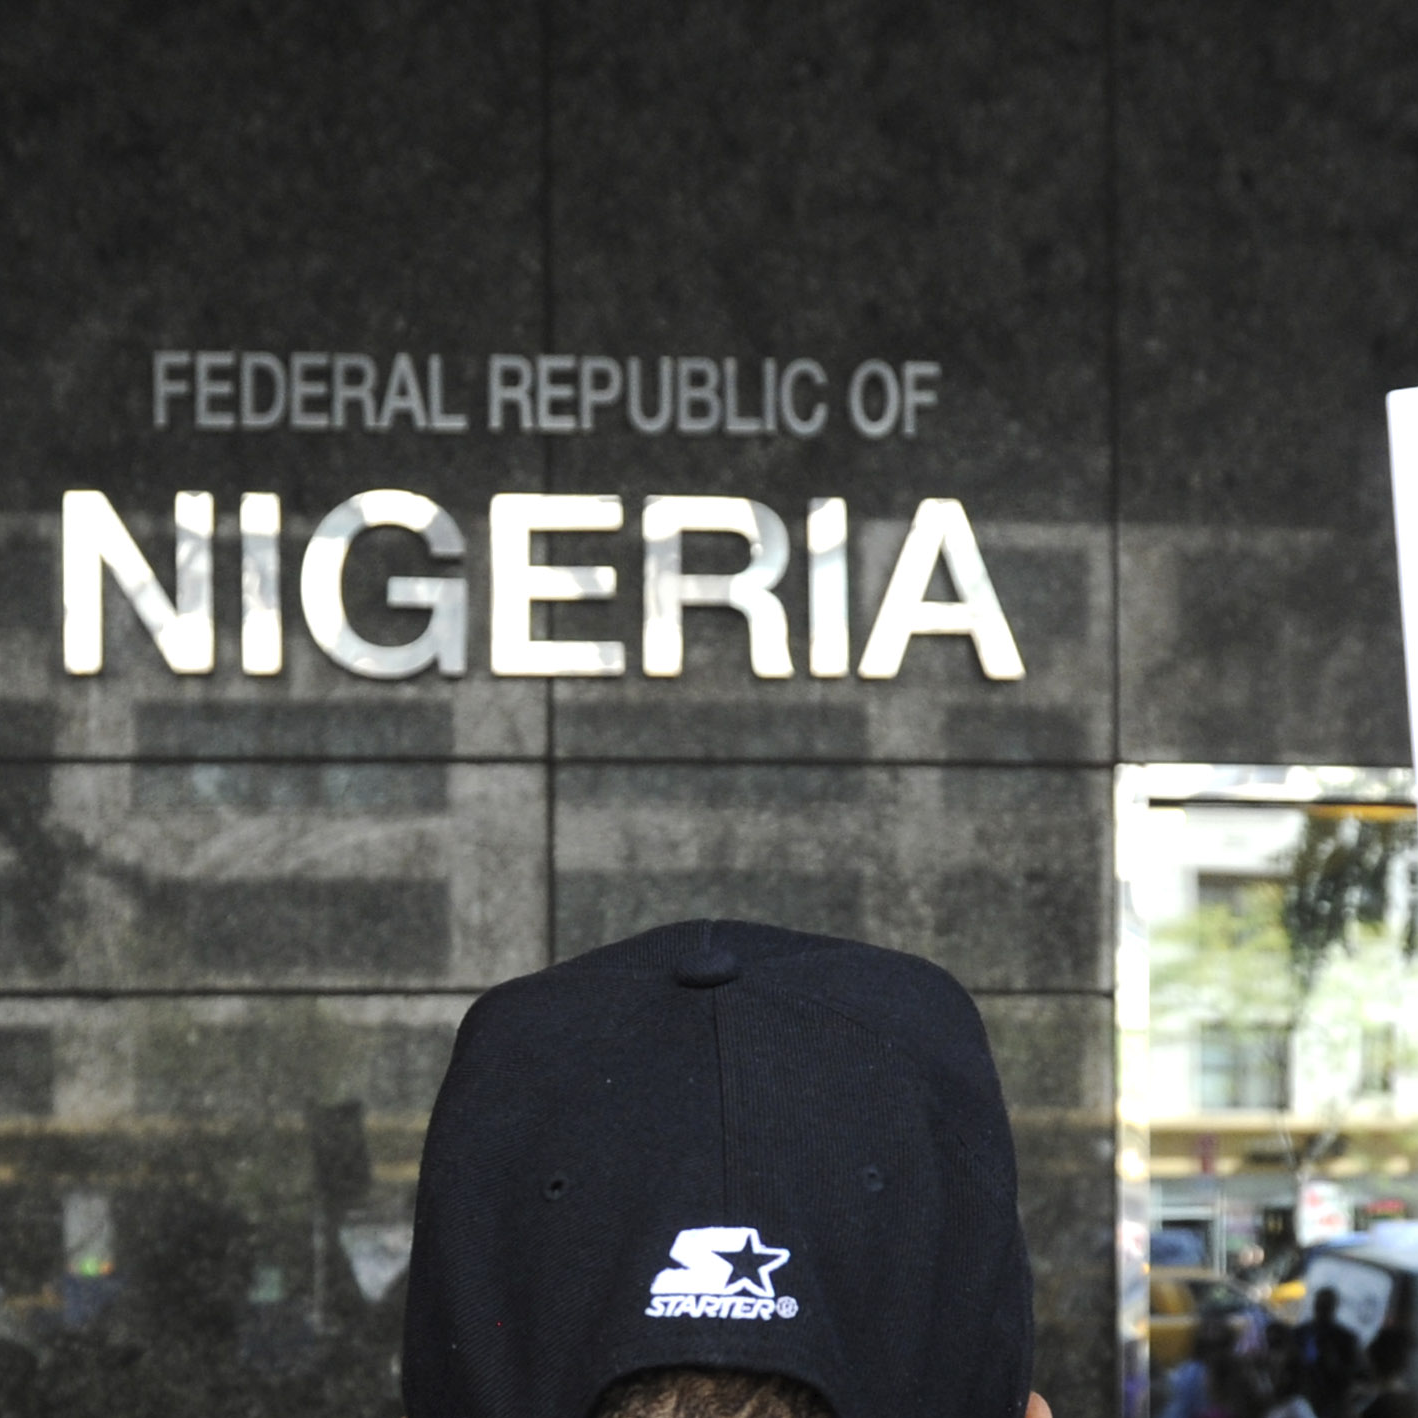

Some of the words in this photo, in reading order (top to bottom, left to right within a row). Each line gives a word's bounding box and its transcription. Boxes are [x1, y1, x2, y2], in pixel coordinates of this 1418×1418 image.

[152, 351, 468, 432] FEDERAL
[488, 354, 827, 437] REPUBLIC
[846, 360, 941, 438] OF
[61, 488, 1026, 680] NIGERIA
